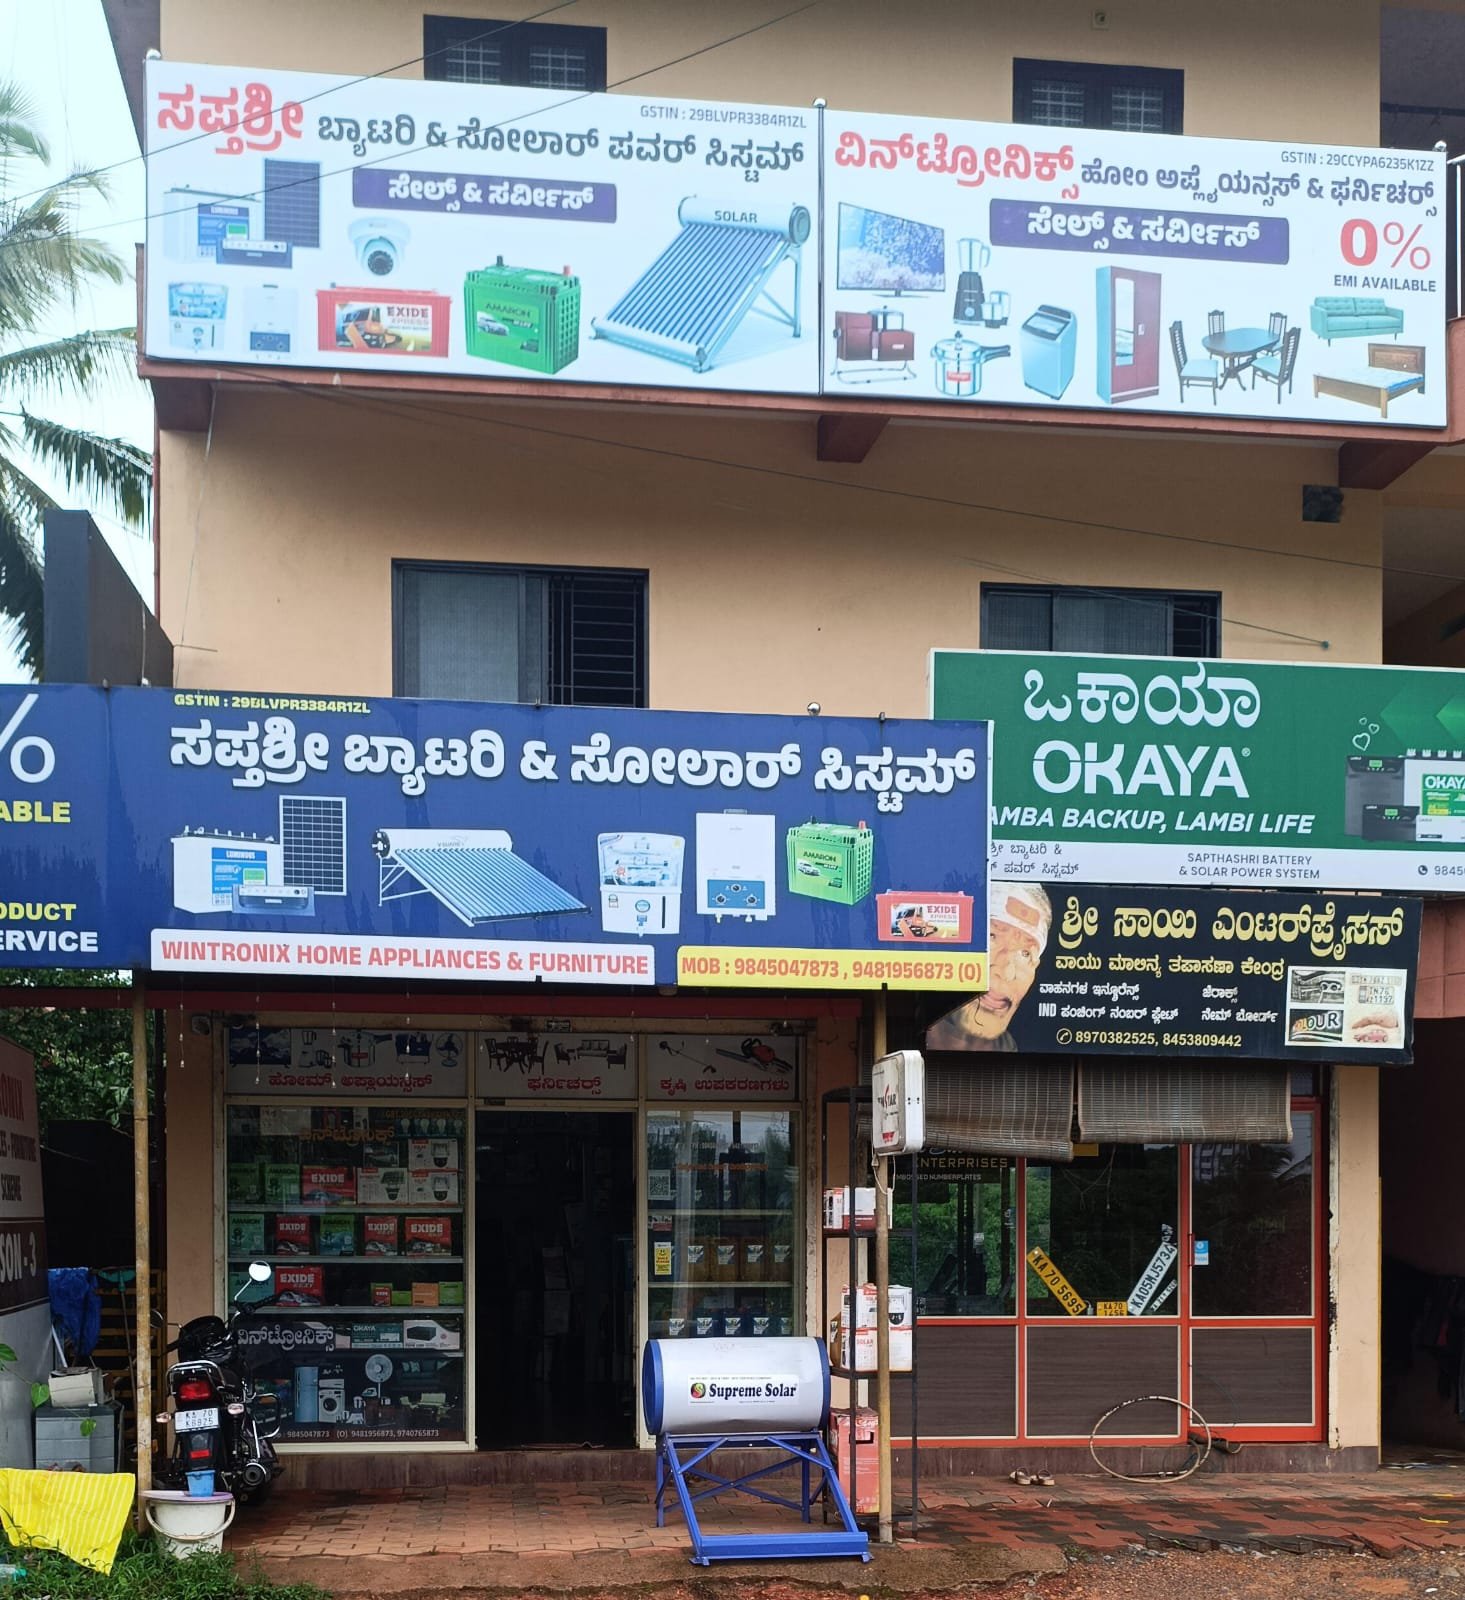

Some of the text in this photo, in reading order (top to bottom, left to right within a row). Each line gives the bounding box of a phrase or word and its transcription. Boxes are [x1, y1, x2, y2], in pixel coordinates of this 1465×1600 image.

[640, 105, 679, 120] GSTIN
[689, 108, 807, 129] 29BLVPR3384R1ZL
[157, 82, 804, 183] ಸಪ್ತಶ್ರೀ ಬ್ಯಾಟರಿ & ಸೋಲಾರ್ ಪವರ್ ಸಿಸ್ಟಮ್
[1281, 151, 1317, 164] GSTIN
[1326, 153, 1435, 172] 29CCYPA6235K1ZZ
[388, 172, 594, 212] ಸೇಲ್ಸ್ & ಸರ್ವೀಸ್
[1306, 178, 1324, 199] &
[1330, 176, 1438, 217] ಫರ್ನಿಚರ್ಸ್
[714, 210, 758, 223] SOLAR
[1028, 205, 1260, 250] ಸೇಲ್ಸ್ & ಸರ್ವೀಸ್
[1340, 218, 1431, 270] 0%
[1333, 274, 1437, 293] EMI AVAILABLE
[387, 306, 429, 319] EXIDE
[1023, 661, 1262, 729] ಒಕಾಯಾ
[174, 694, 220, 707] GSTIN
[231, 696, 371, 714] 29BLVPR3384R1ZL
[170, 716, 976, 813] ಸಪ್ತಶ್ರೀ ಬ್ಯಾಟರಿ & ಸೋಲಾರ್ ಸಿಸ್ಟಮ್
[1032, 739, 1250, 799] OKAYA
[1424, 775, 1465, 789] OKAY
[991, 805, 1315, 835] AMBA BACKUP, LAMBI LIFE
[803, 850, 837, 862] AMARON
[1010, 843, 1047, 860] ಬ್ಯಾಟರಿ
[1054, 844, 1062, 856] &
[1187, 852, 1312, 865] SAPTHASHRI BATTERY
[1004, 861, 1036, 874] ಪವರ್
[1042, 862, 1079, 878] ಸಿಸ್ಟಮ್
[1178, 866, 1320, 879] & SOLAR POWER SYSTEM
[1434, 866, 1465, 876] 9845
[927, 905, 957, 914] EXIDE
[1058, 895, 1099, 949] ಶ್ರೀ
[1113, 907, 1197, 939] ಸಾಯಿ
[161, 940, 648, 975] WINTRONIX HOME APPLIANCES & FURNITURE
[682, 957, 720, 974] MOB
[734, 959, 839, 978] 9845047873
[1055, 952, 1285, 982] ವಾಯು ಮಾಲಿನ್ಯ ತಪಾಸಣಾ ಕೇಂದ್ರ
[1039, 981, 1088, 995] ವಾಹನಗಳ
[1038, 1002, 1057, 1017] IND
[1110, 1006, 1147, 1019] ನಂಬರ್
[1201, 1007, 1232, 1021] ನೇಮ್
[1075, 1031, 1242, 1047] 8970382525, 8453809442
[918, 1157, 1008, 1169] NTERPRISES
[311, 1173, 345, 1184] EXIDE
[279, 1223, 306, 1231] EXIDE
[368, 1223, 395, 1232] EXIDE
[410, 1224, 443, 1233] EXIDE
[280, 1273, 315, 1283] EXIDE
[1032, 1254, 1084, 1315] KA 70 5695
[709, 1383, 796, 1400] Supreme Solar
